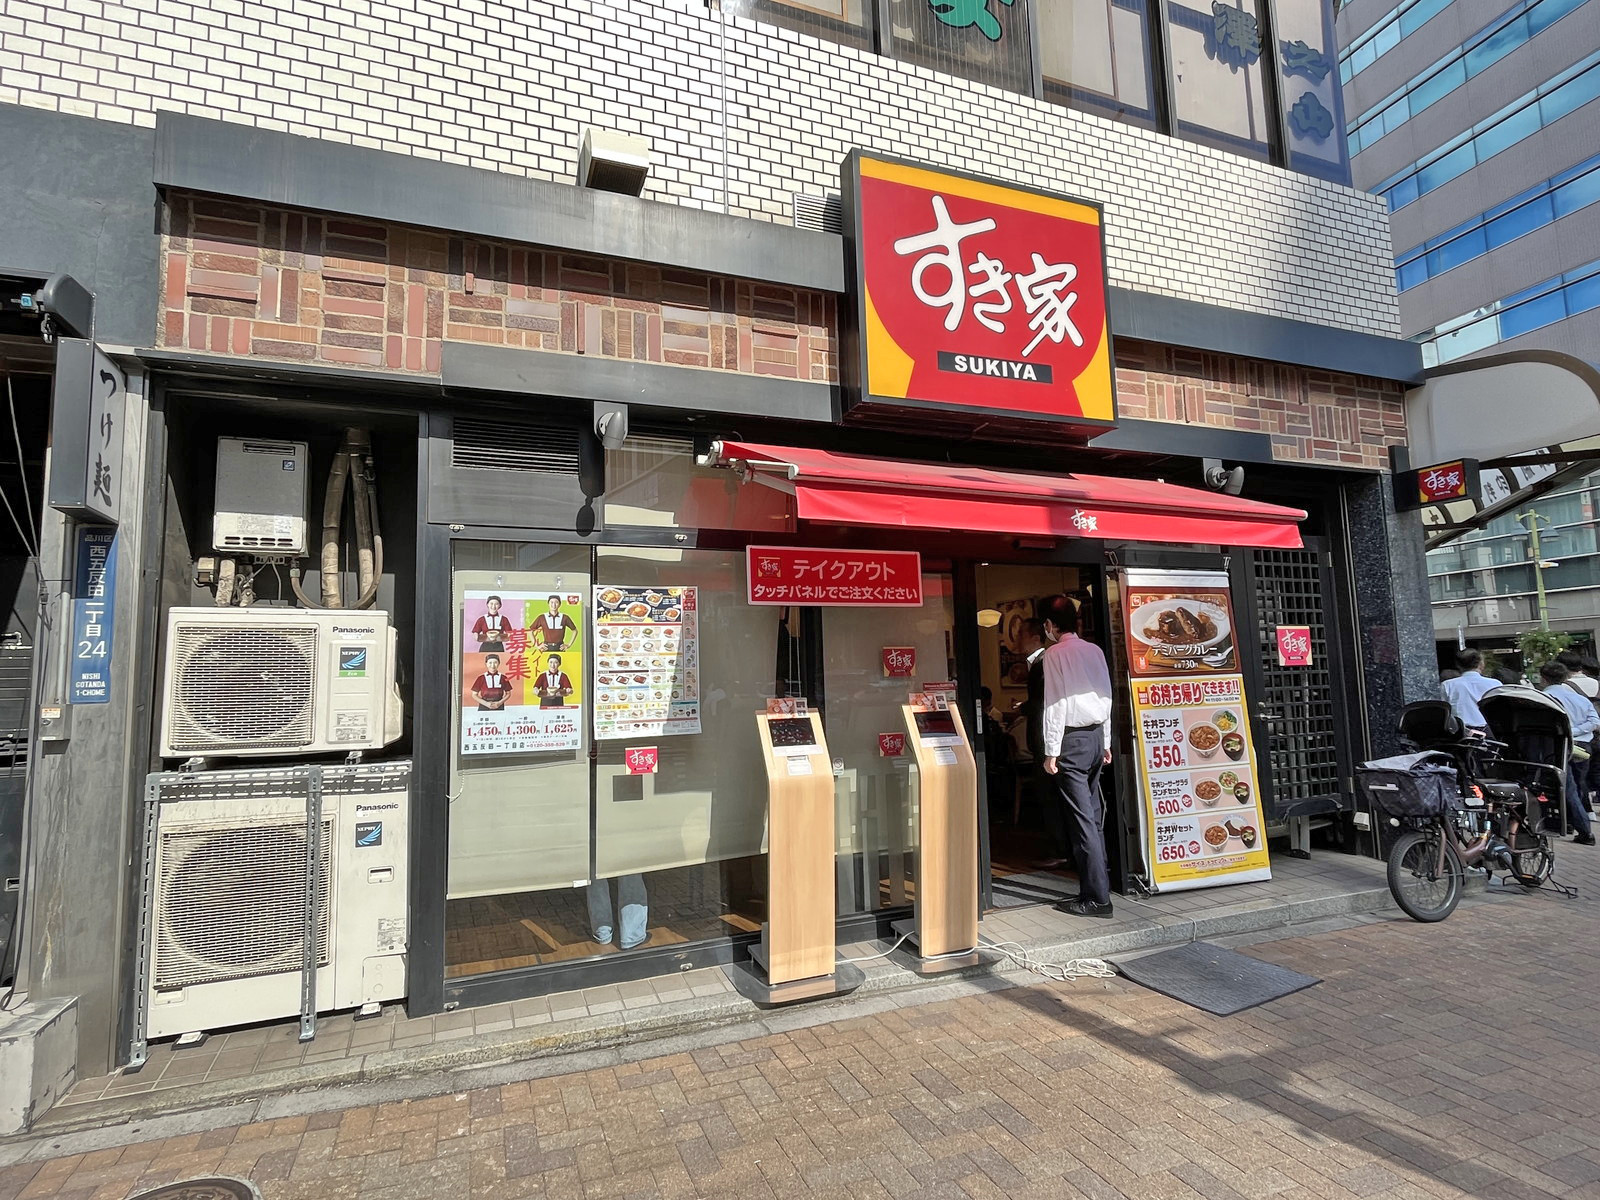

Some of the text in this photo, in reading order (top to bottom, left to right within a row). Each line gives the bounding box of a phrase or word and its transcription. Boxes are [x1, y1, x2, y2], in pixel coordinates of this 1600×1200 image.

[894, 195, 1084, 357] すき家
[954, 355, 1037, 381] SUKIYA
[1424, 470, 1460, 490] すき家
[1070, 509, 1098, 532] すき家
[85, 534, 112, 542] 品川区
[793, 559, 896, 581] テイクアウト
[86, 545, 107, 637] 西五反田一丁目
[754, 584, 917, 600] タッチパネルでご注文ください
[332, 626, 375, 634] Panasonic
[78, 640, 107, 659] 24
[1281, 629, 1308, 655] すき家
[505, 628, 532, 681] 募集
[888, 649, 912, 668] すき家
[76, 689, 105, 697] 1-CHOME
[1143, 718, 1180, 729] 牛丼ランチ
[882, 735, 901, 750] すき家
[1145, 730, 1165, 739] セット
[629, 750, 655, 766] すき家
[355, 803, 399, 812] Panasonic
[1157, 825, 1194, 835] 牛丼Wセット
[1157, 834, 1174, 843] ランチ
